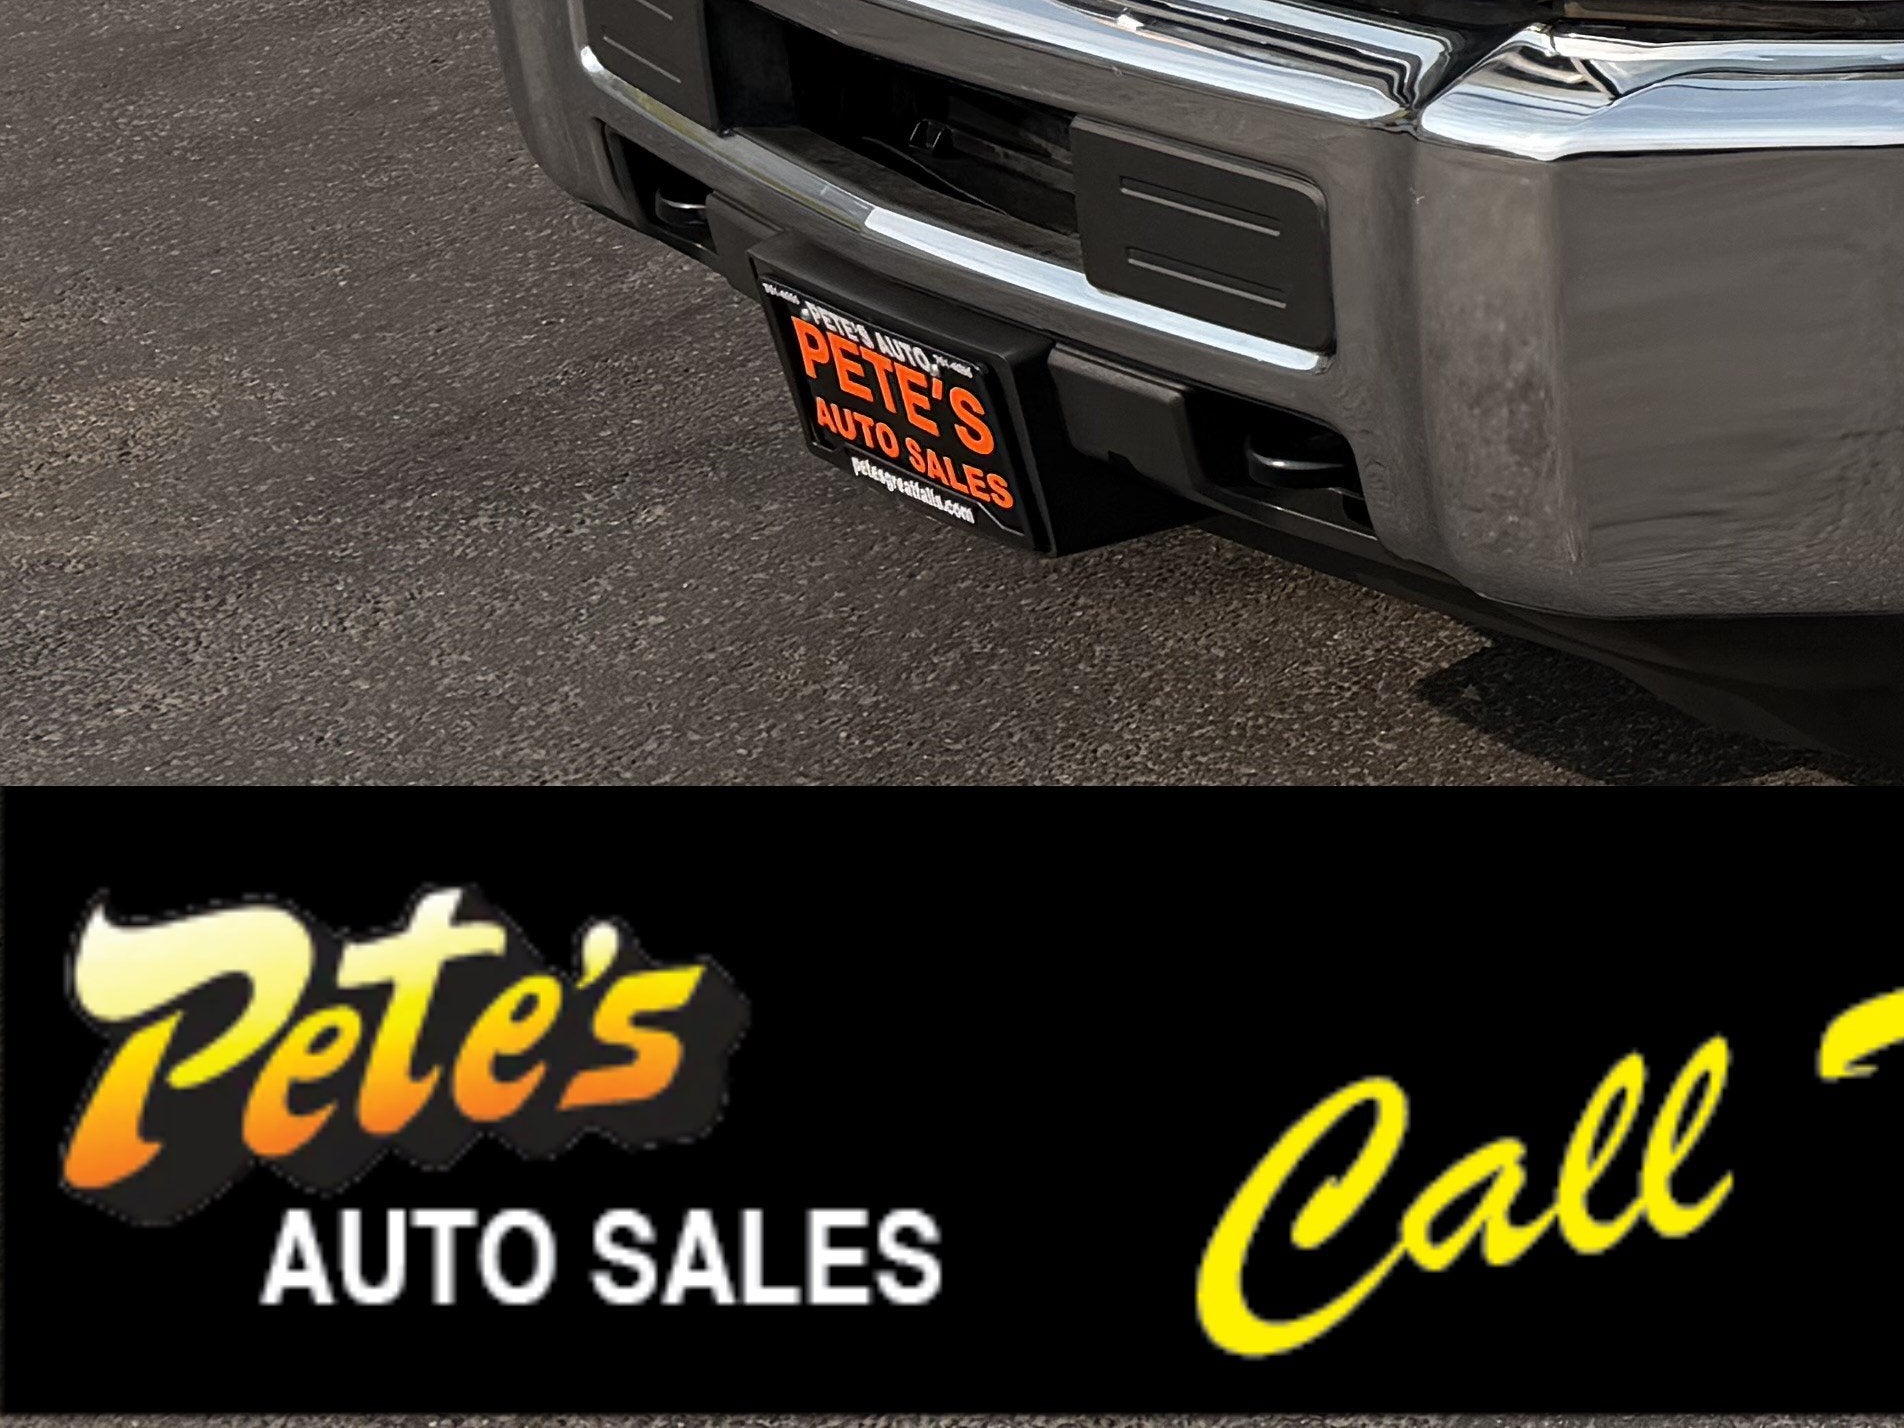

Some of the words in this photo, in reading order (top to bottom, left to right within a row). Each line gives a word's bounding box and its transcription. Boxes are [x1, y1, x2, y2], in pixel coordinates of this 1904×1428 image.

[791, 315, 996, 455] PETE'S
[805, 301, 875, 350] PETE'S
[874, 331, 930, 371] AUTO
[816, 396, 900, 458] AUTO
[905, 437, 1015, 510] SALES
